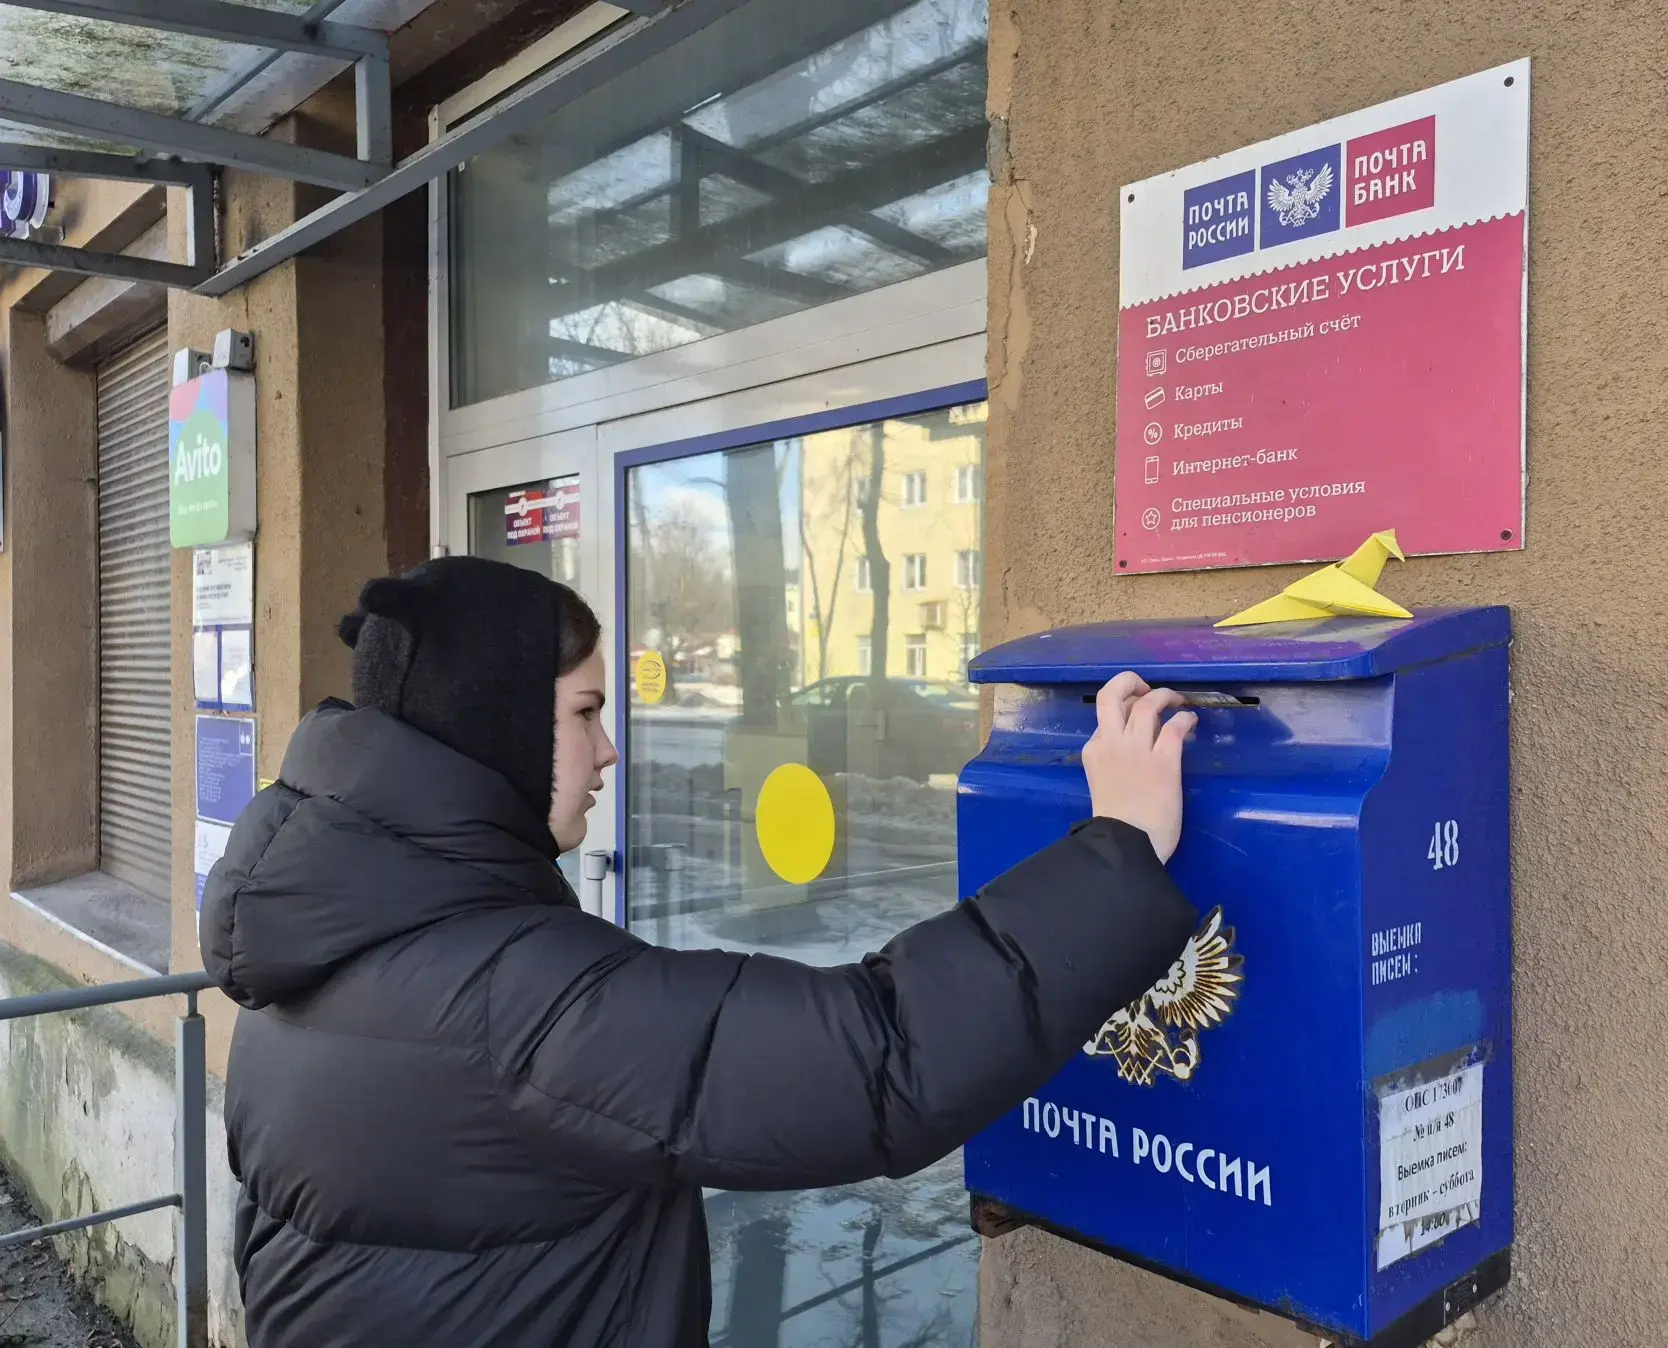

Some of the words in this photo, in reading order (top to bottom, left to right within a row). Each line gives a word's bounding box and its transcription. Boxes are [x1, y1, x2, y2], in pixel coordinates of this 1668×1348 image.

[1354, 139, 1427, 179] ПОЧТА
[1354, 170, 1417, 206] БАНК
[1188, 191, 1248, 224] ПОЧТА
[1188, 215, 1249, 250] РОССИИ
[1146, 274, 1329, 339] БАНКОВСКИЕ
[1338, 245, 1465, 295] УСЛУГИ
[1175, 322, 1315, 364] Сберегательный
[1319, 313, 1361, 335] счёт
[1175, 381, 1224, 401] Карты
[1174, 417, 1244, 440] Кредиты
[174, 433, 222, 485] Avito
[1172, 448, 1298, 476] Интернет-банк
[1171, 488, 1285, 513] Специальные
[1289, 480, 1366, 502] условия
[1171, 516, 1199, 532] для
[1202, 504, 1317, 528] пенсионеров
[1427, 819, 1459, 871] 48
[1372, 922, 1422, 957] ВЫЕМКА
[1444, 1111, 1454, 1129] 48
[1022, 1096, 1119, 1158] ПОЧТА
[1132, 1127, 1272, 1207] РОССИИ
[1398, 1156, 1435, 1181] Выемка
[1436, 1142, 1467, 1164] писем:
[1439, 1169, 1475, 1198] суббота
